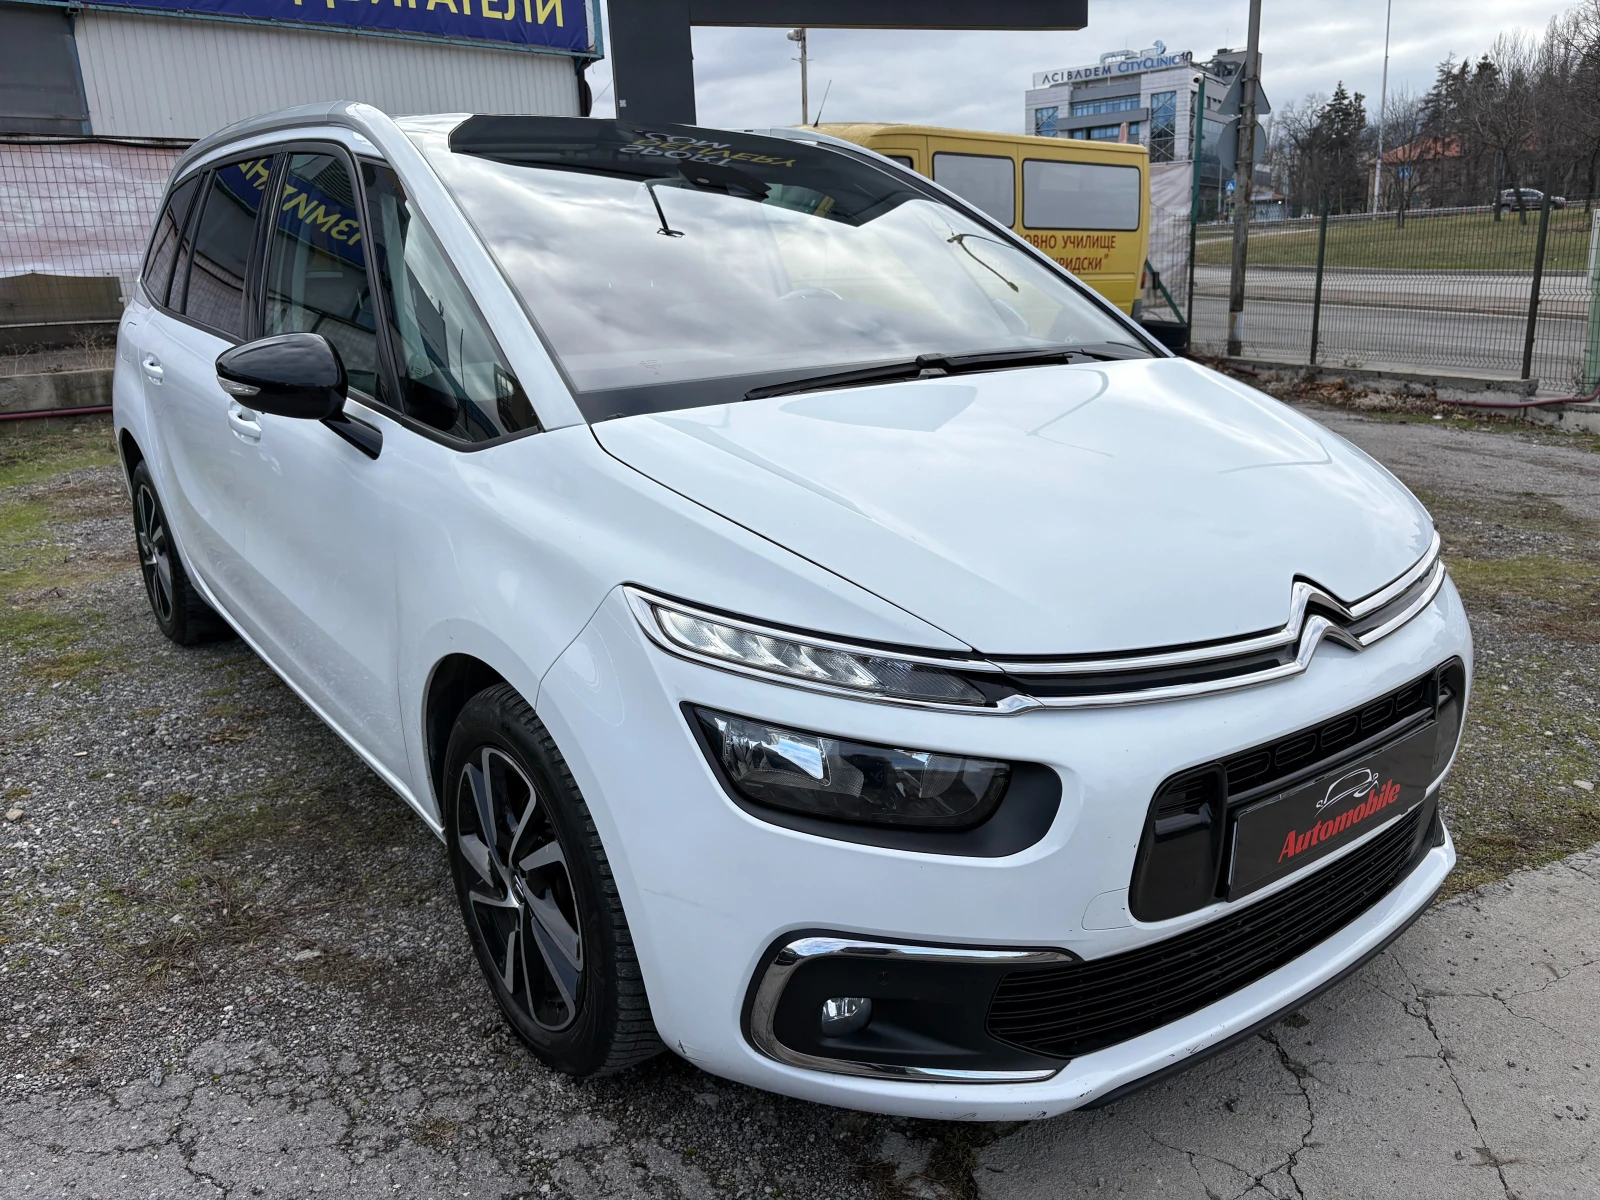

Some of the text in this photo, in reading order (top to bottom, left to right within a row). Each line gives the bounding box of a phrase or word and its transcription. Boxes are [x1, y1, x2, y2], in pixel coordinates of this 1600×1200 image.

[1042, 65, 1112, 84] ACIBADEM
[1021, 234, 1116, 252] ОВНО УЧИЛИЩЕ
[1278, 778, 1401, 863] Automobile
